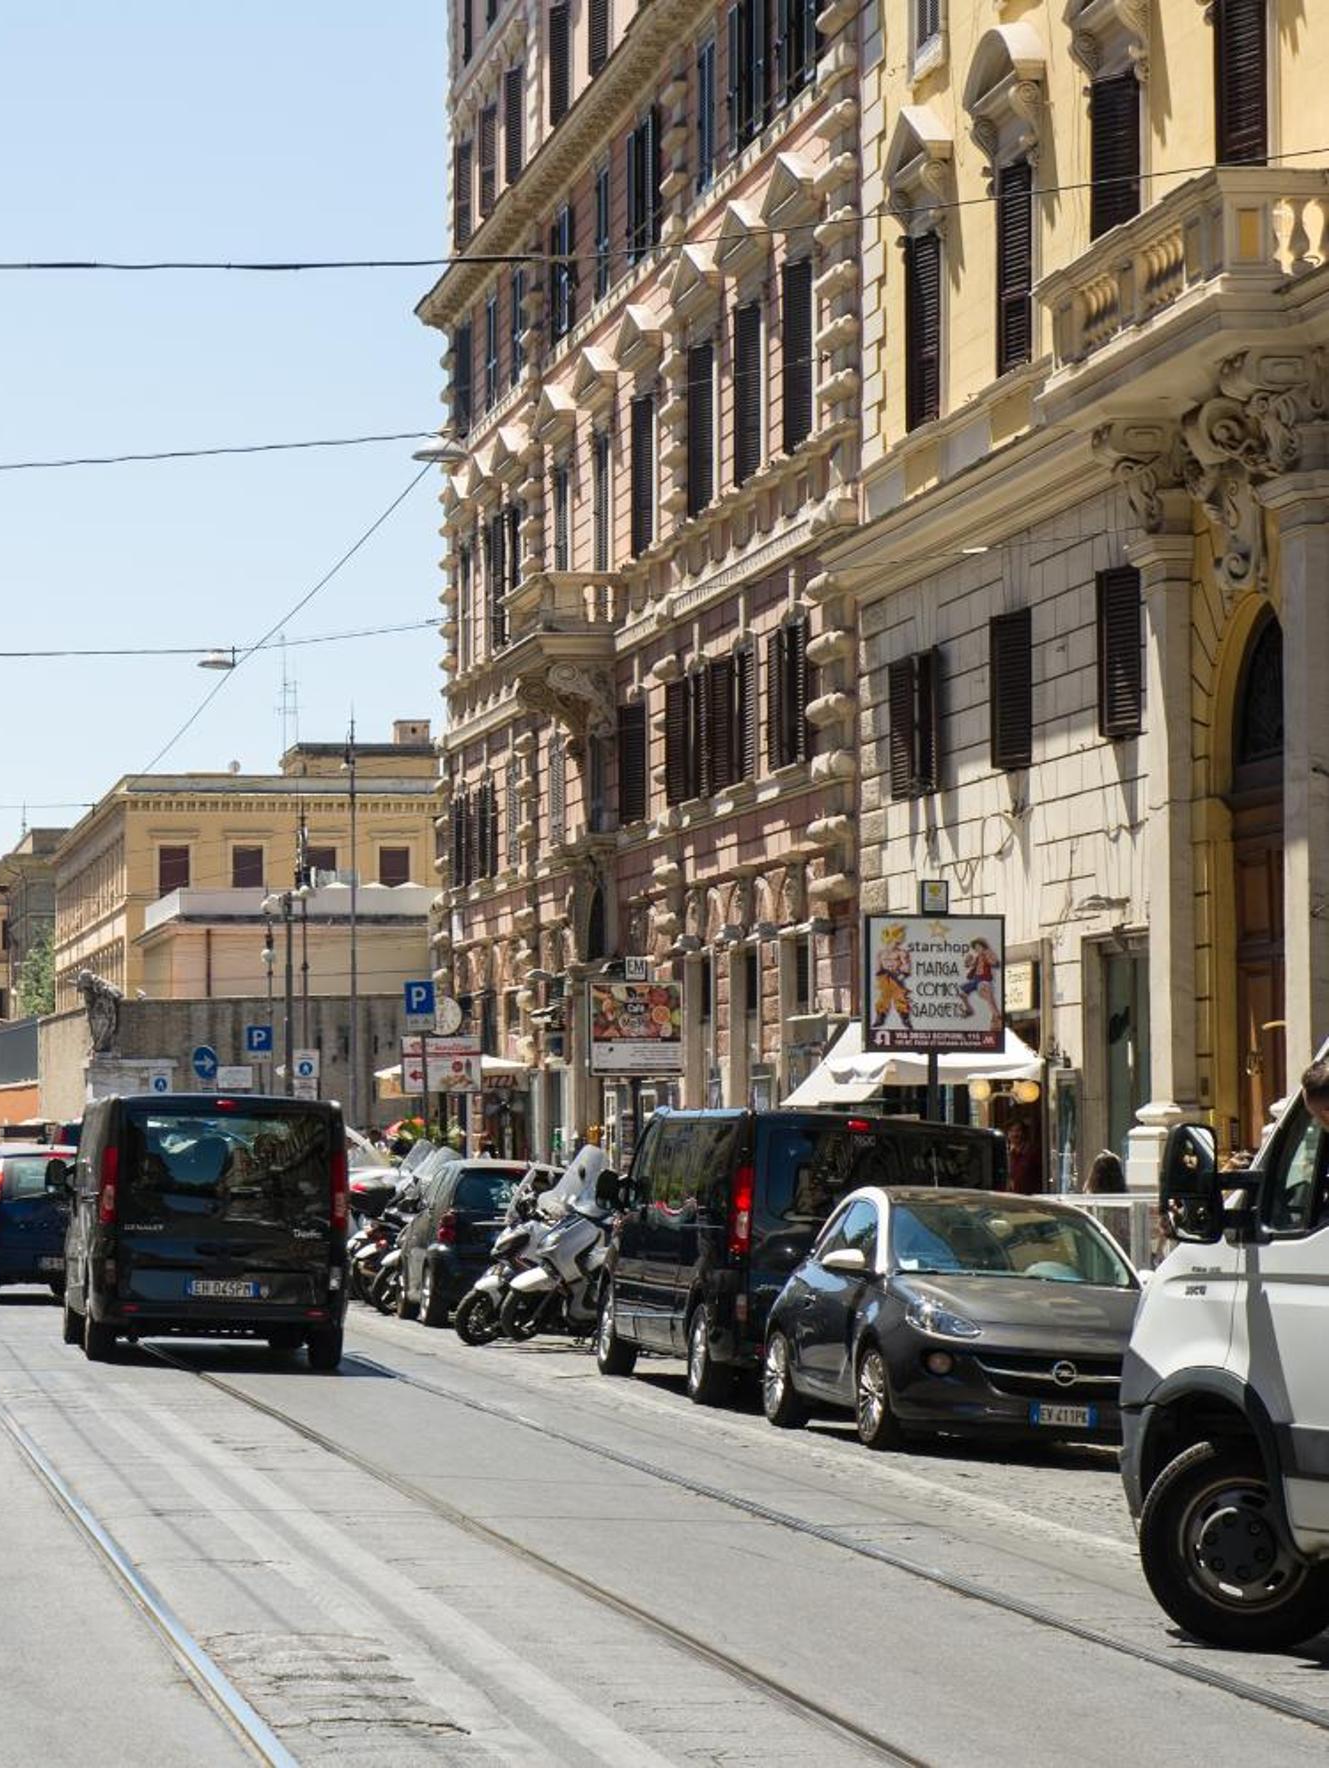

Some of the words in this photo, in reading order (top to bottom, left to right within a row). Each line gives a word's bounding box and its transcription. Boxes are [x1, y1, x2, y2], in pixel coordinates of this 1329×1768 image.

[907, 940, 970, 956] starshop
[916, 961, 959, 976] MANGA
[411, 986, 426, 1009] P
[916, 982, 960, 997] COMICS
[912, 1002, 965, 1018] GADGETS
[252, 1030, 266, 1047] P
